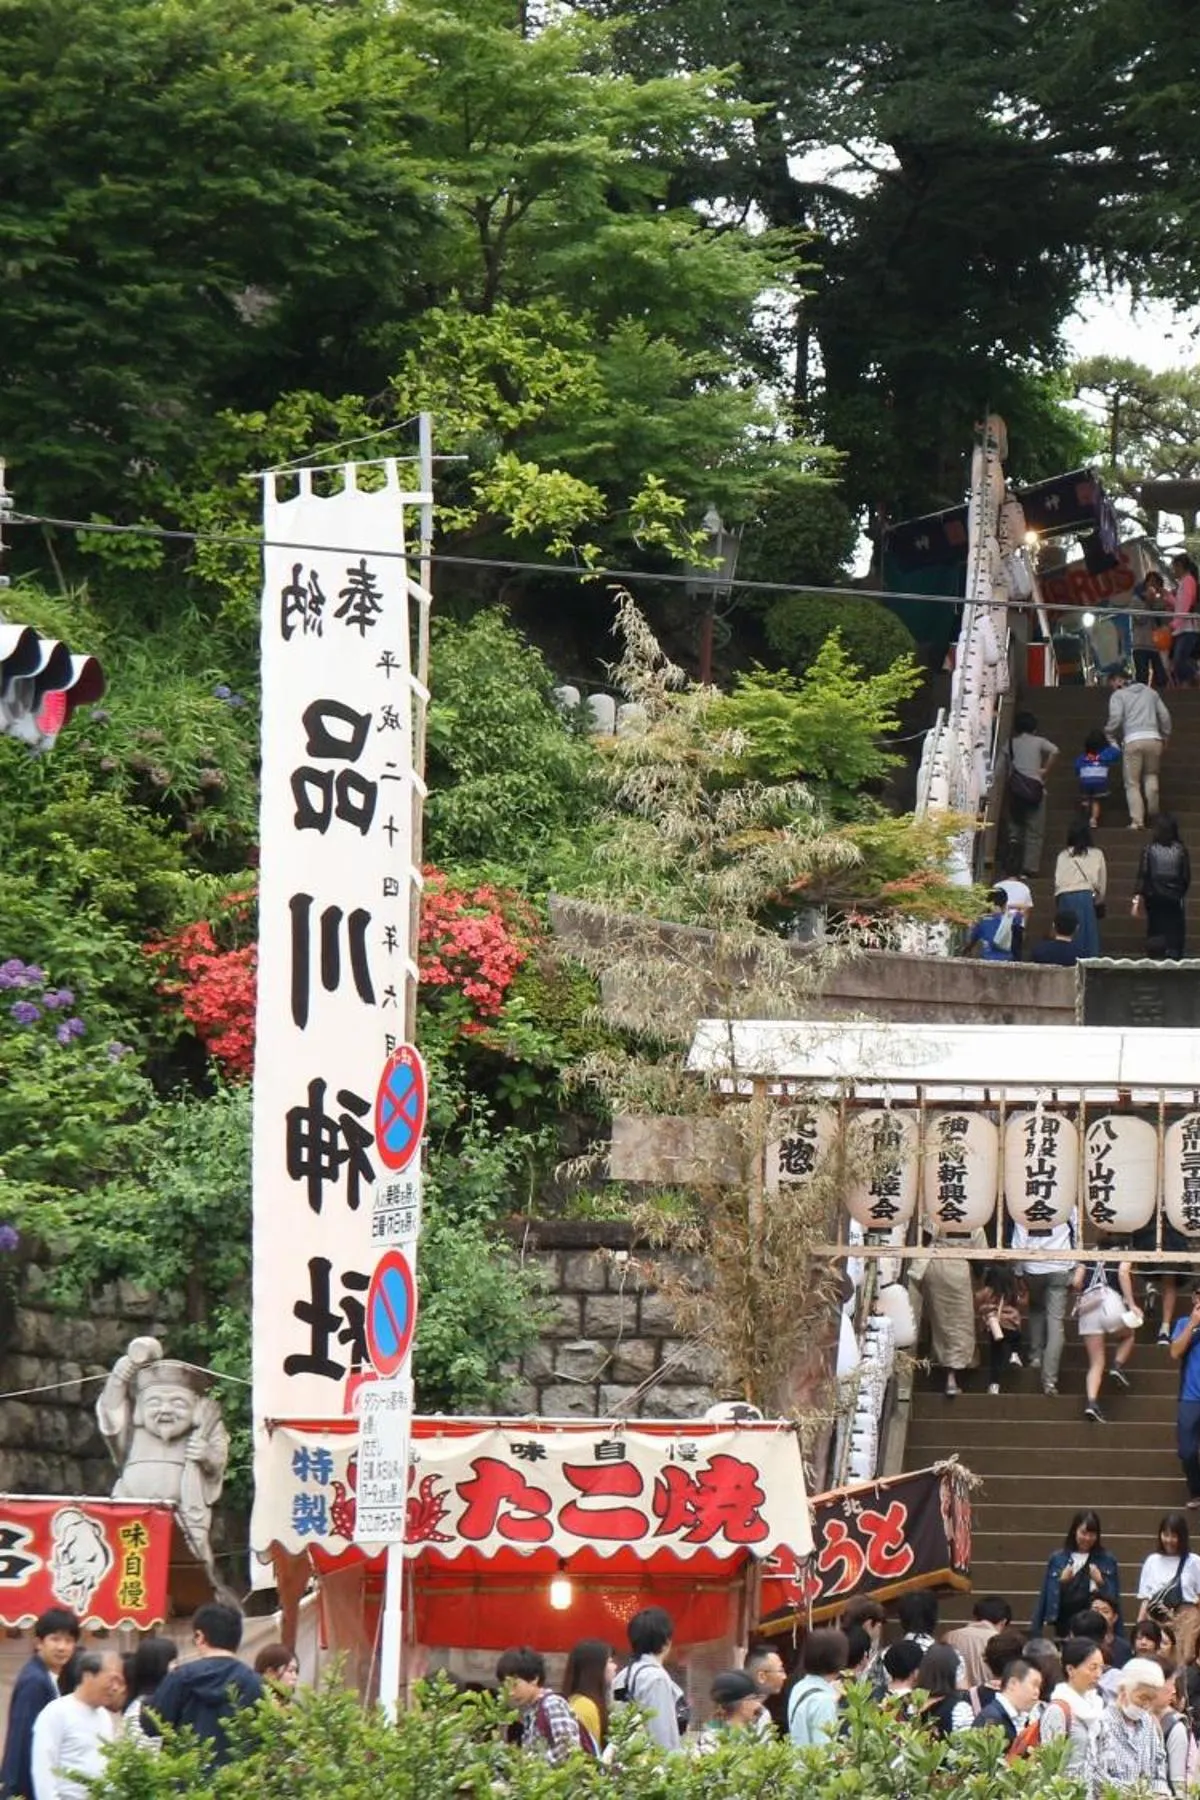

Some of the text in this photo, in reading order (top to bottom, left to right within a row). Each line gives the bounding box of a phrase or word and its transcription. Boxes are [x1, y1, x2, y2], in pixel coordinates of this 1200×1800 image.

[291, 1445, 334, 1537] 特製
[456, 1453, 770, 1544] たこ焼
[118, 1521, 149, 1609] 味自慢
